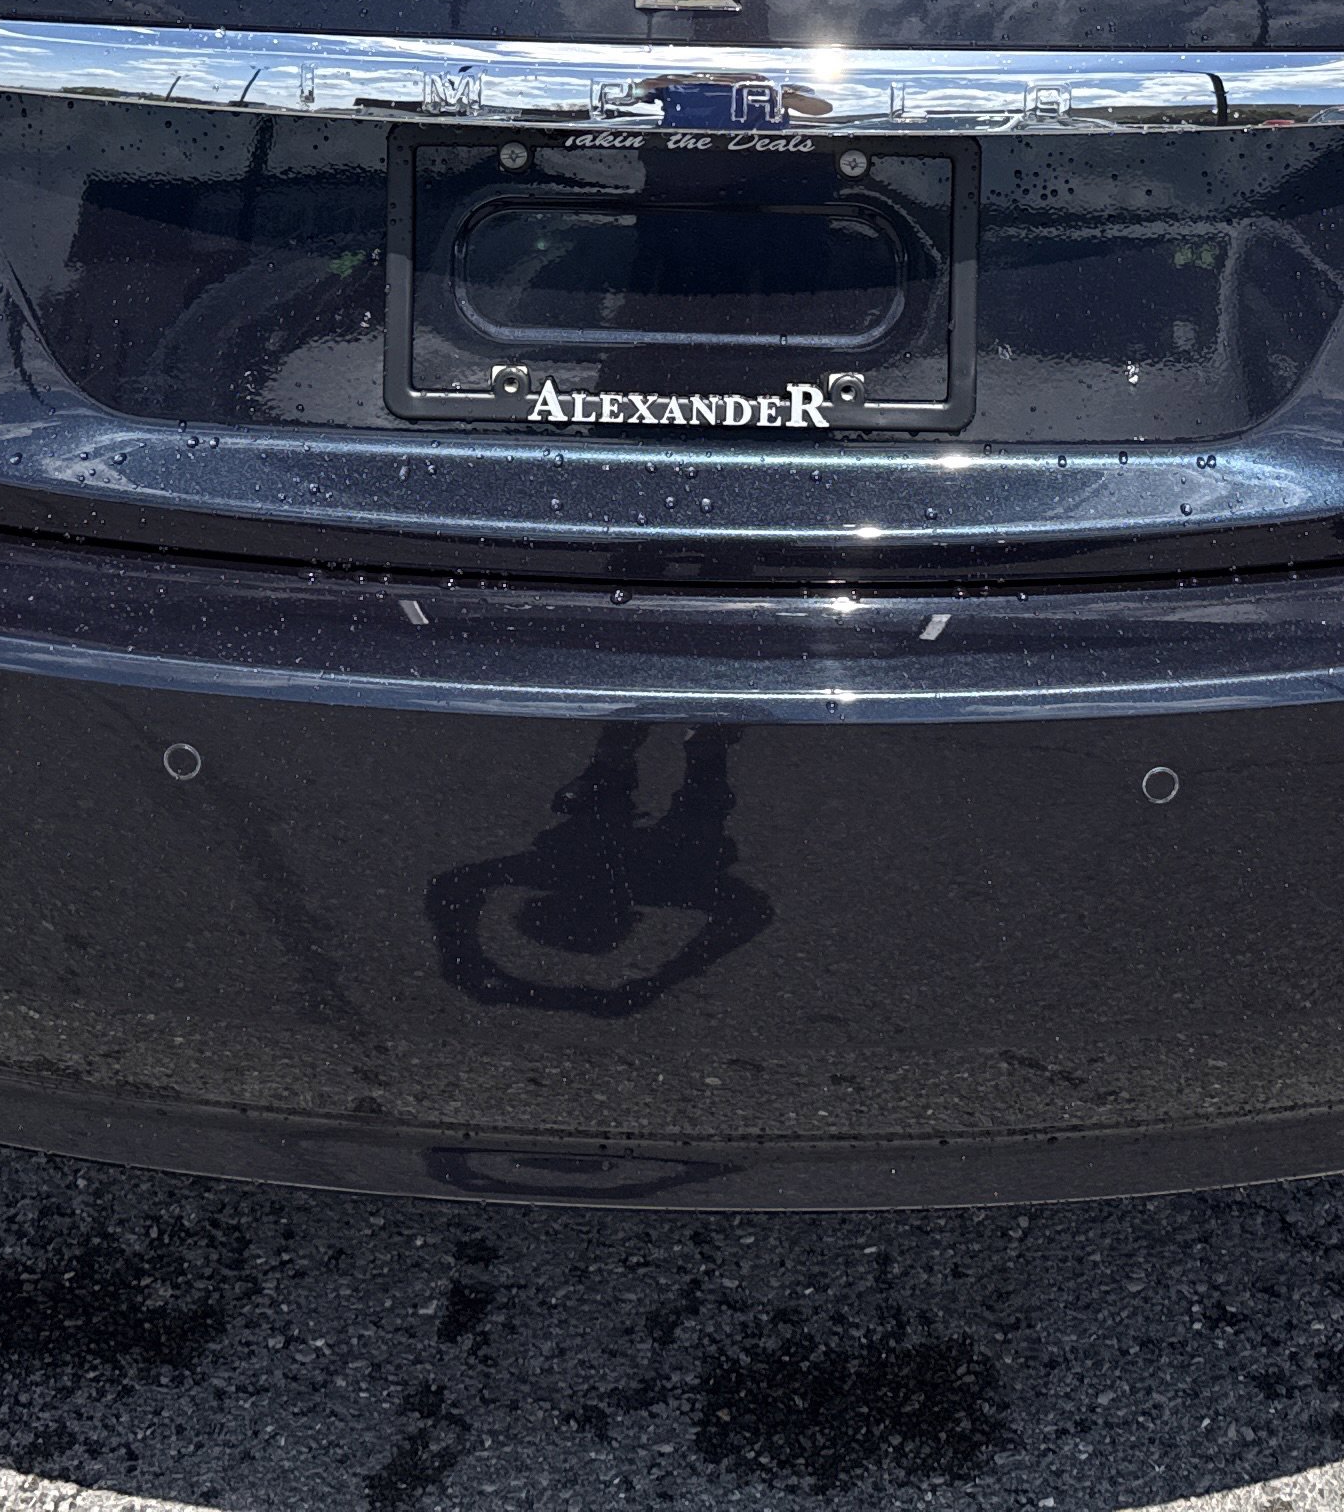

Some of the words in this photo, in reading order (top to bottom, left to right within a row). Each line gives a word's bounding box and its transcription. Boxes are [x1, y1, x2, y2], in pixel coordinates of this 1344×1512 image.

[300, 61, 1072, 124] IMPALA
[666, 133, 713, 151] the
[727, 133, 816, 153] Deals
[527, 378, 831, 429] ALEXANDER
